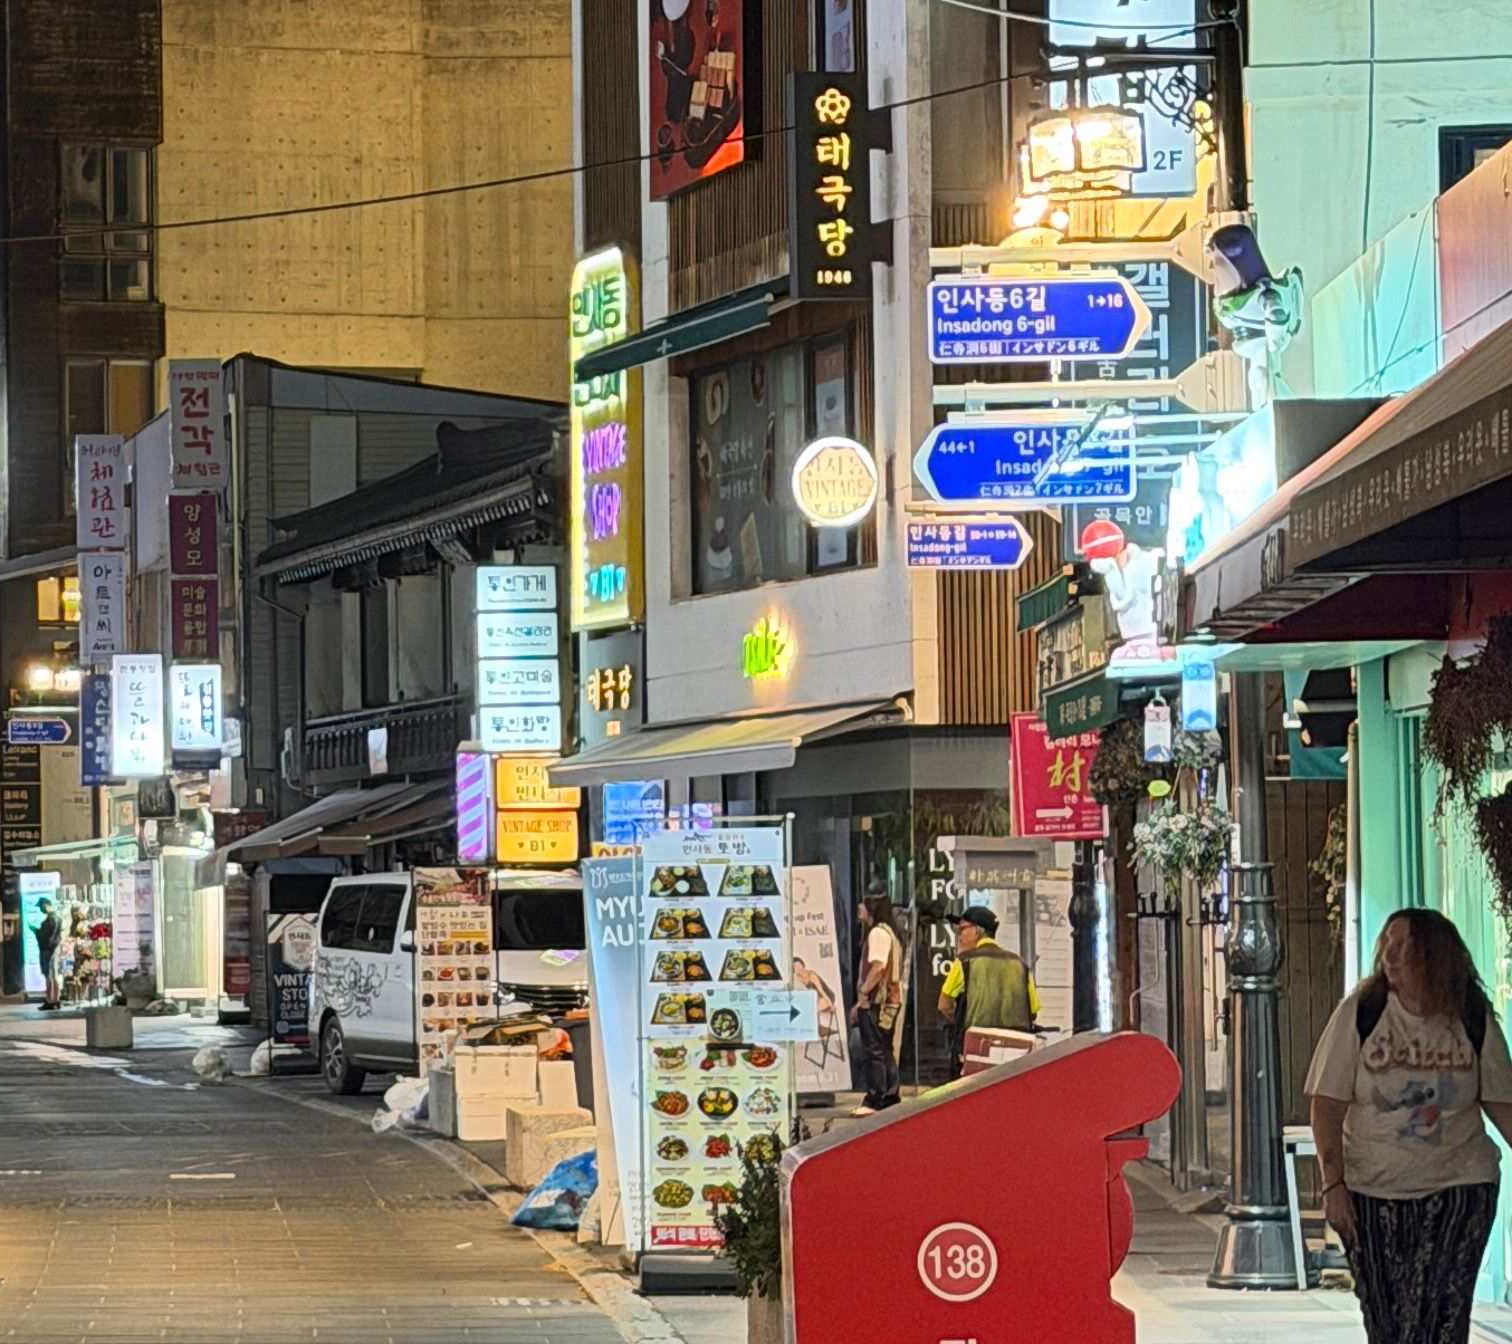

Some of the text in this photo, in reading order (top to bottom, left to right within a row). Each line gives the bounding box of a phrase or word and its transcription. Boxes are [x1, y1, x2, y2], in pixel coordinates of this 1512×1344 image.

[1152, 149, 1184, 171] 2F
[815, 131, 854, 258] 태극당
[937, 287, 1047, 313] 인사동6길
[937, 316, 1056, 336] Insadong 6-gil
[180, 386, 215, 456] 전각
[90, 461, 116, 538] 체험관
[805, 478, 868, 498] VINTAGE
[910, 525, 966, 542] 인사동길
[501, 819, 573, 834] VINTAGE SHOP
[927, 1243, 986, 1280] 138
